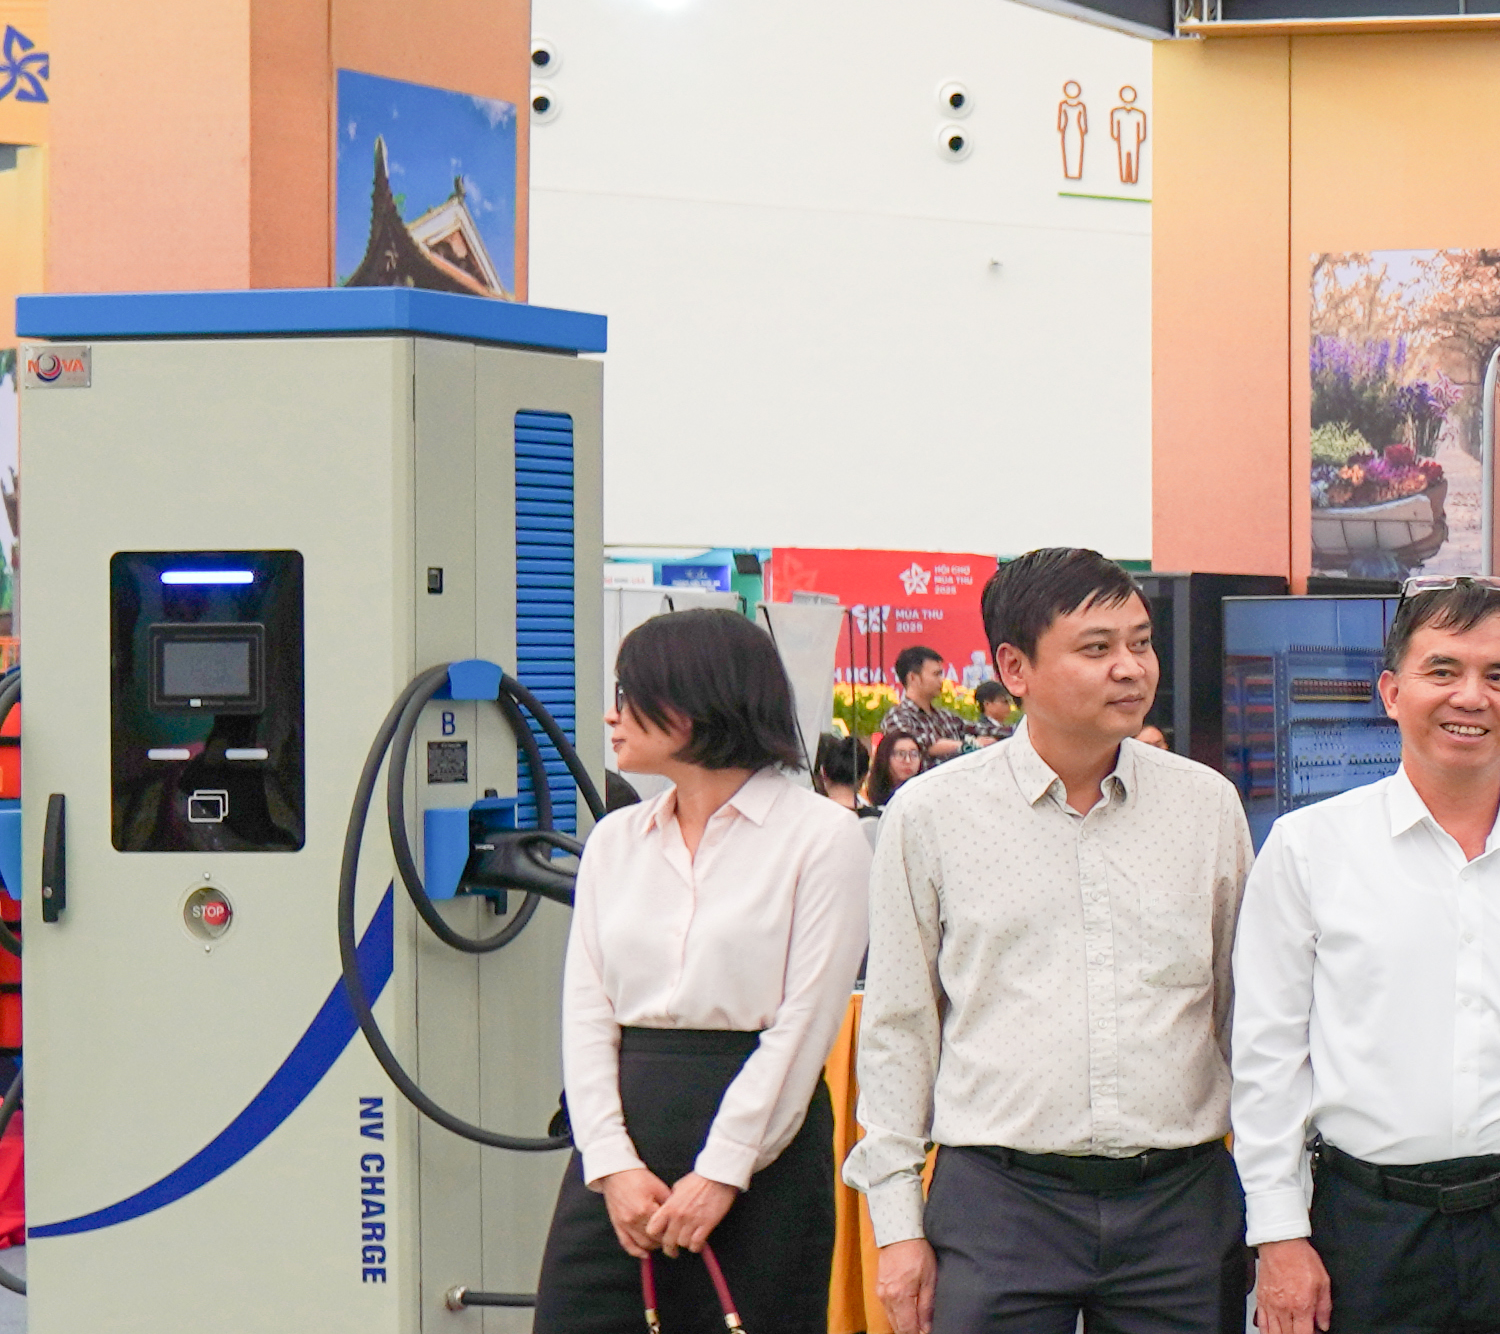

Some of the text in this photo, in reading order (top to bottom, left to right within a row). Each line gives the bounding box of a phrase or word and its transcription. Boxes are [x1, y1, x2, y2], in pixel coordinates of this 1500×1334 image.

[441, 711, 456, 736] B
[193, 905, 225, 917] STOP
[359, 1097, 387, 1284] NV CHARGE
